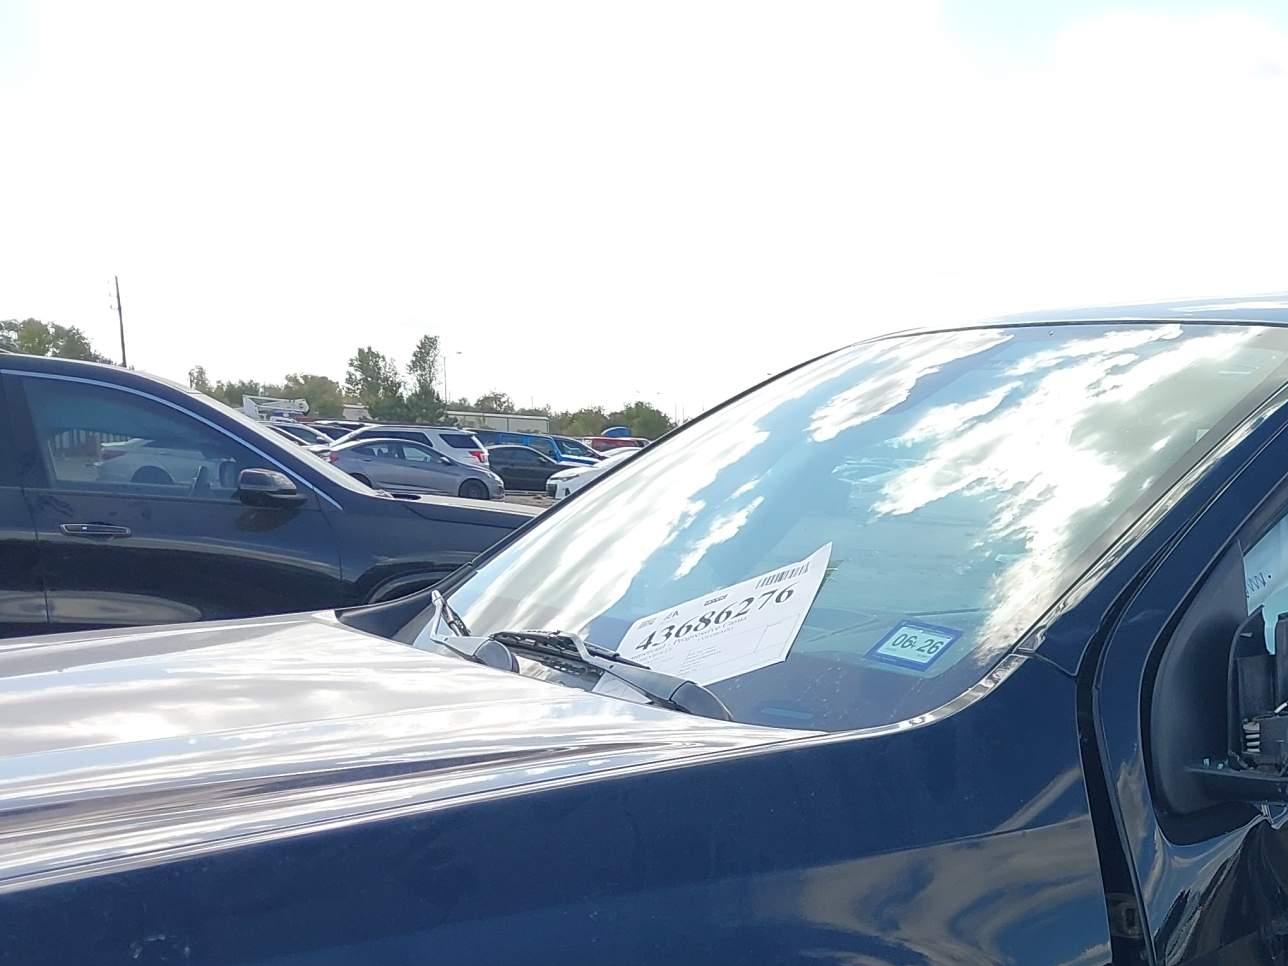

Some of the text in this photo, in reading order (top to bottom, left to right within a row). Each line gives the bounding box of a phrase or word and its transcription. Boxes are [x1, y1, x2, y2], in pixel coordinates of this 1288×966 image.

[635, 583, 799, 651] 43686276
[892, 634, 917, 649] 06
[916, 639, 944, 655] 26
